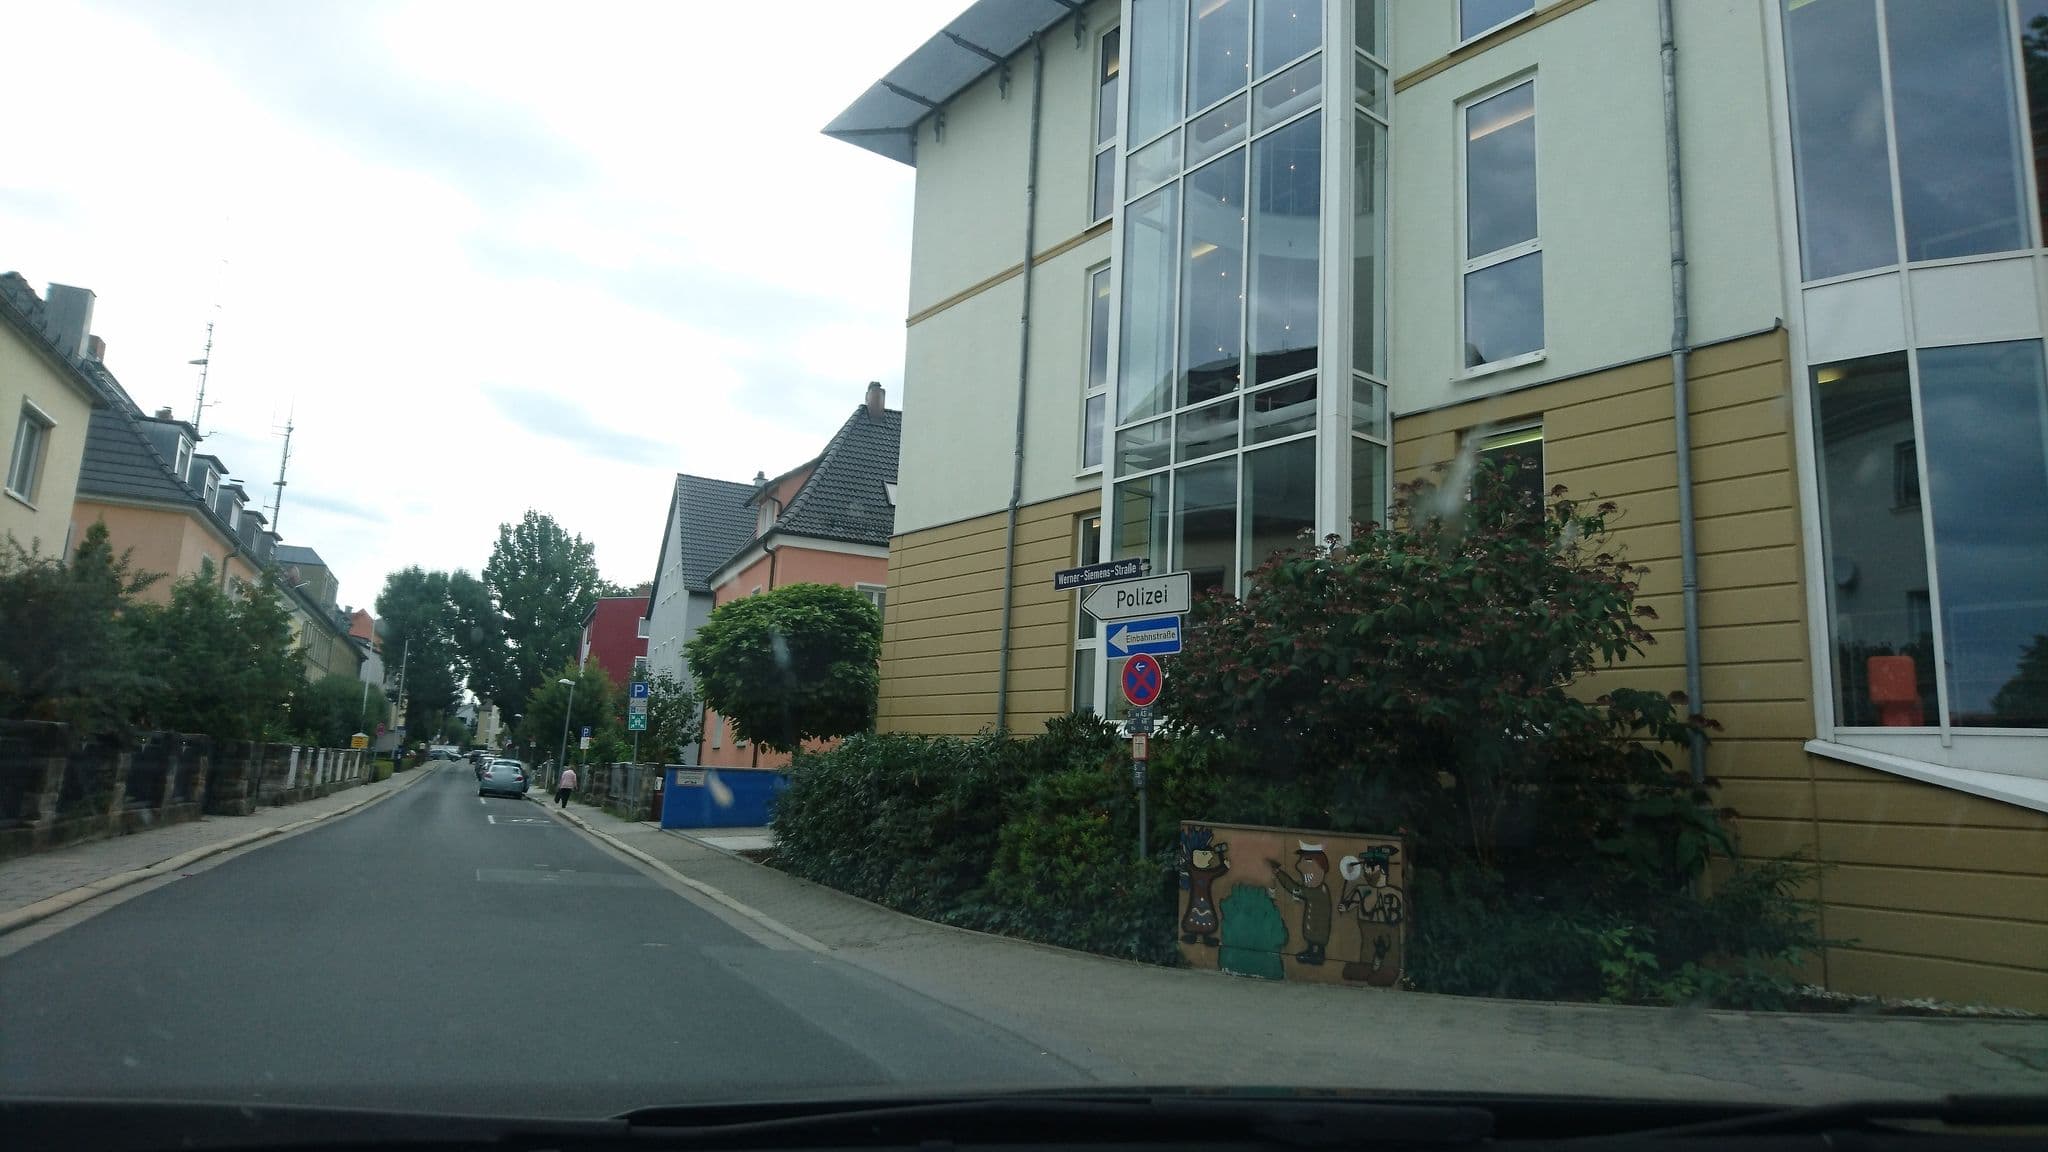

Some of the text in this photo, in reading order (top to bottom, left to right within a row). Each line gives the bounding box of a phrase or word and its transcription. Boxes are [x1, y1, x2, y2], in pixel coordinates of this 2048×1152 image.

[1058, 562, 1137, 585] Werner-Siemens-Straße
[1116, 584, 1169, 609] Polizei
[1125, 630, 1176, 644] Einbahnstraße
[634, 684, 644, 697] P
